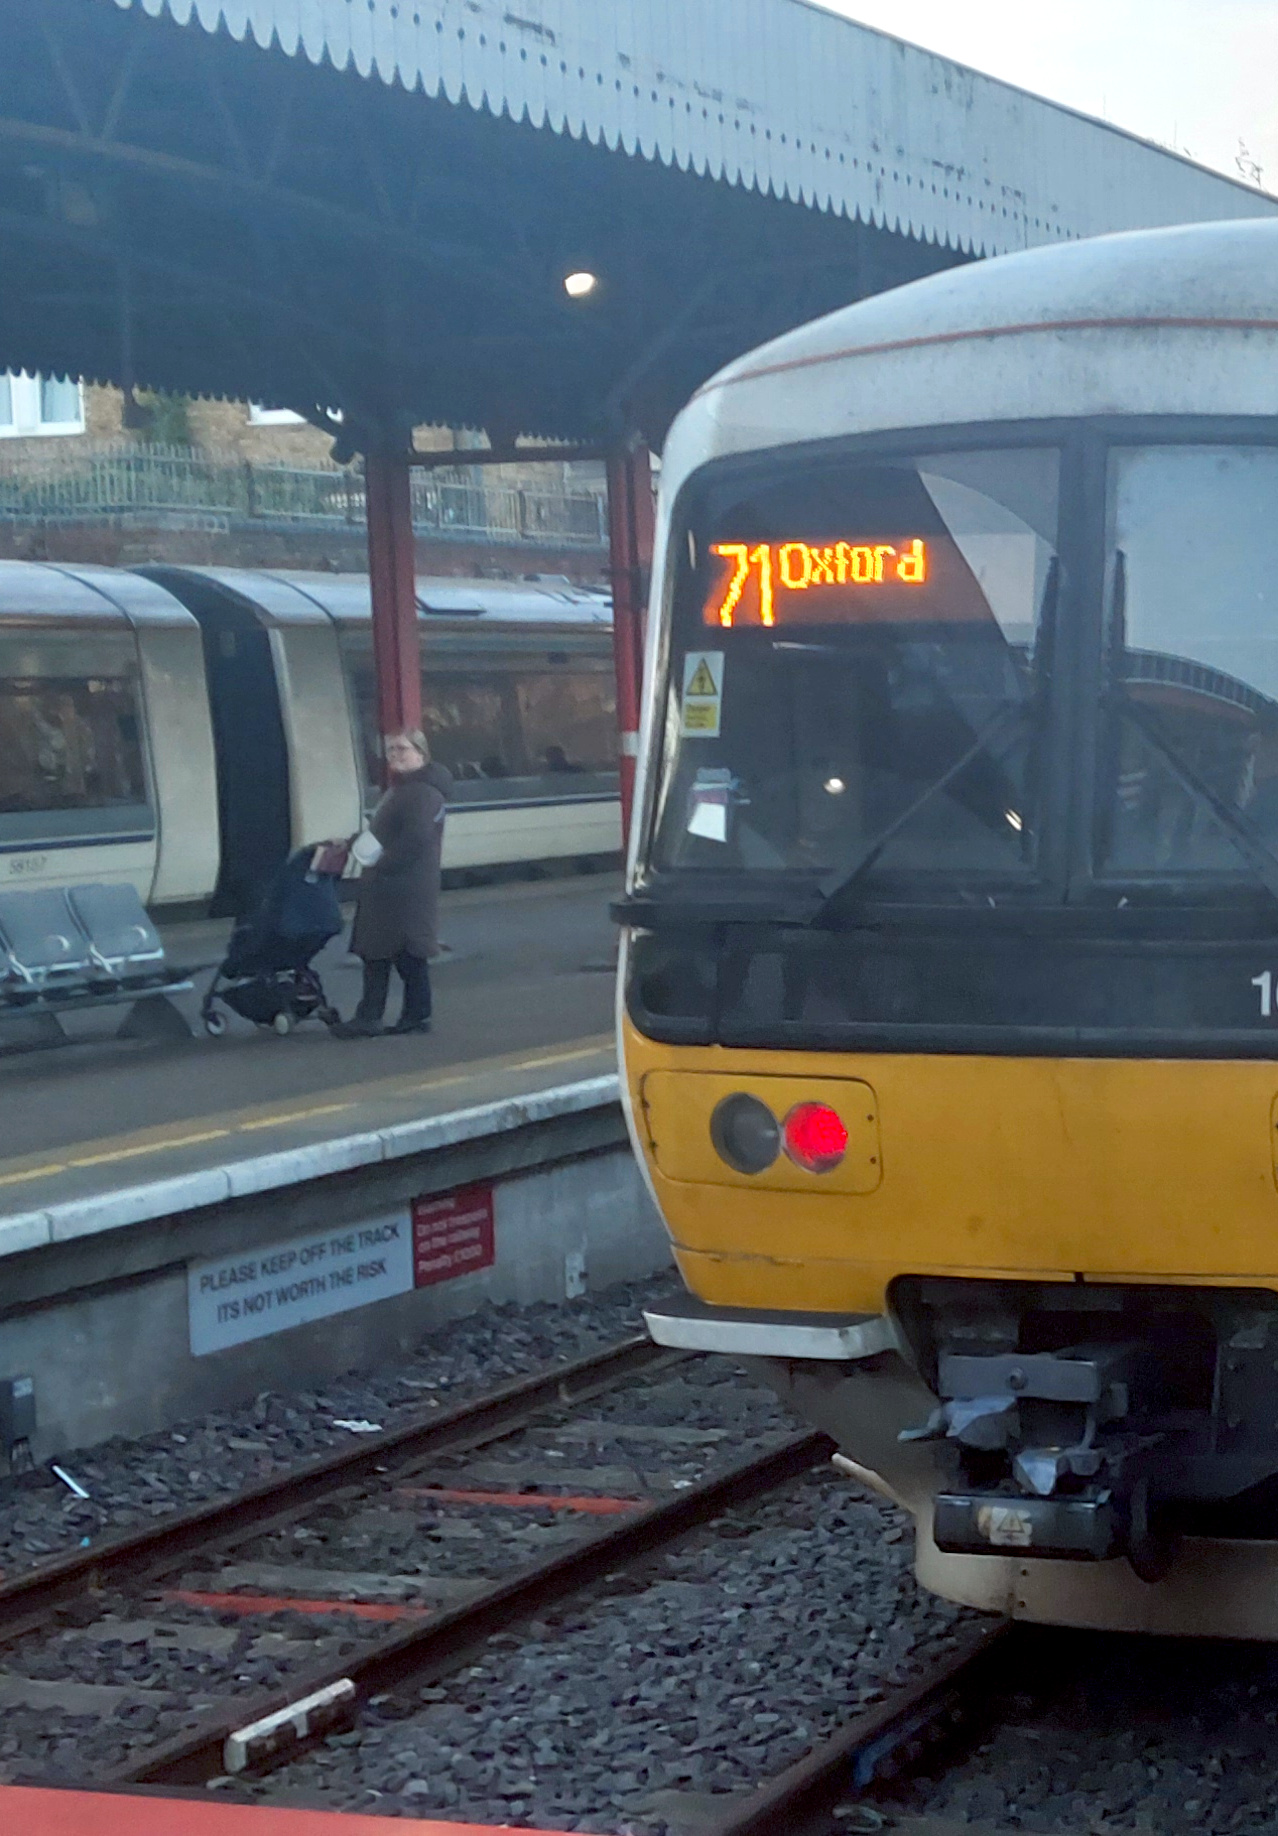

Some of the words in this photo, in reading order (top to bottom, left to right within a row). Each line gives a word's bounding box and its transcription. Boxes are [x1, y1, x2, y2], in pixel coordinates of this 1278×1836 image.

[716, 543, 775, 628] 71
[779, 539, 925, 589] Oxford
[200, 1262, 258, 1293] PLEASE
[260, 1251, 297, 1277] KEEP
[299, 1242, 326, 1266] OFF
[330, 1234, 355, 1256] THE
[358, 1223, 400, 1248] TRACK
[243, 1290, 273, 1315] NOT
[275, 1275, 326, 1305] WORTH
[329, 1266, 353, 1289] THE
[356, 1257, 387, 1281] RISK
